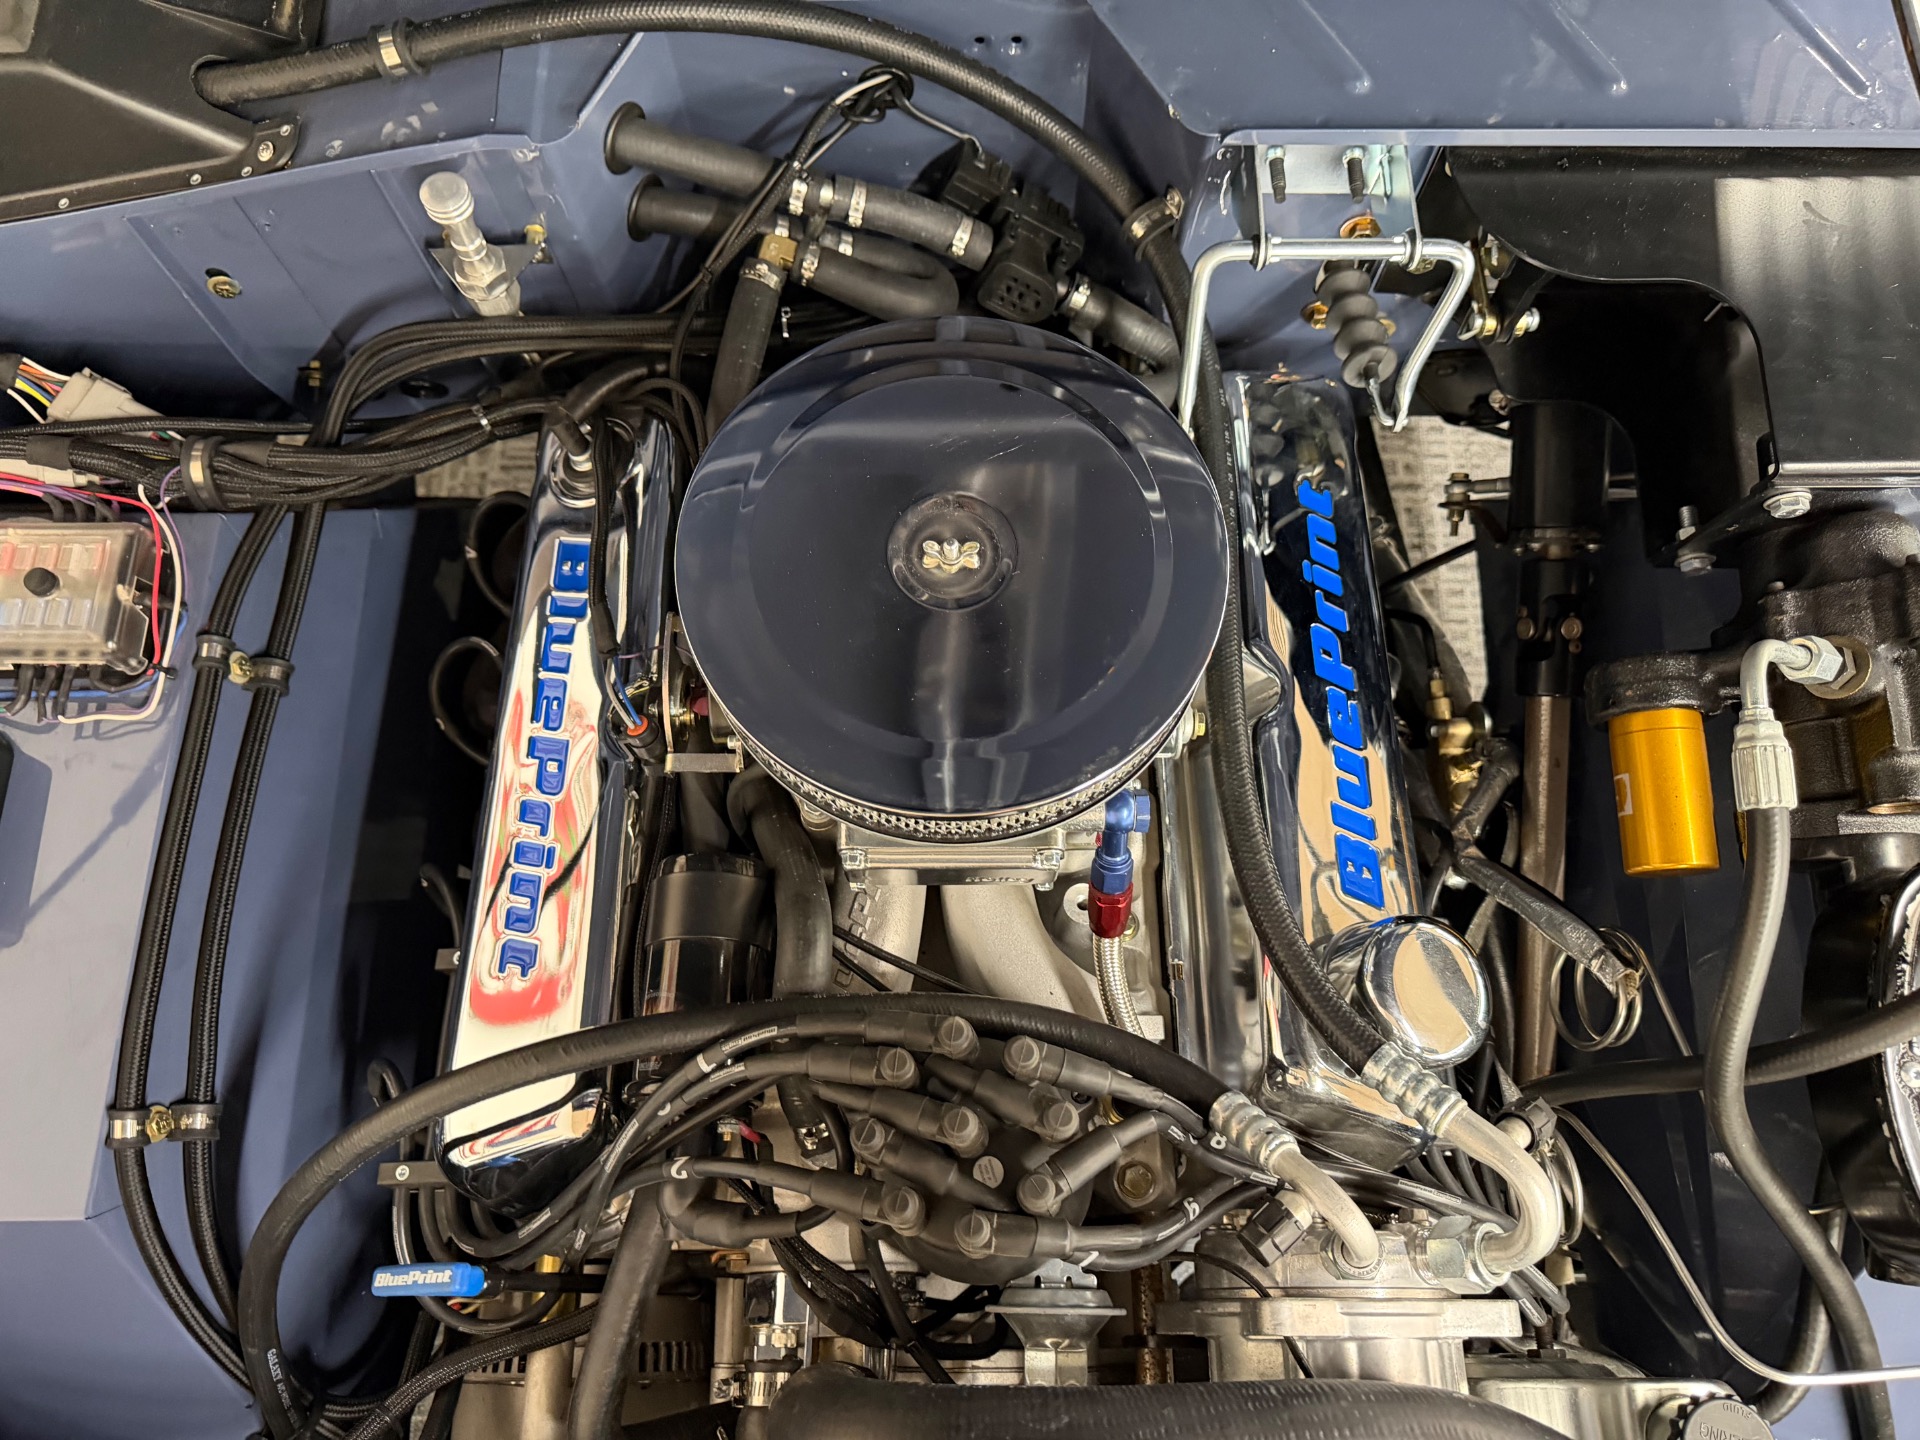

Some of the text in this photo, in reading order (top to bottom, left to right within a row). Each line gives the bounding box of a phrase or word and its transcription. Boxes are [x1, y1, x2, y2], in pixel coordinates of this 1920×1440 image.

[1298, 479, 1384, 909] BluePrint
[498, 537, 591, 979] BluePrint
[670, 1156, 691, 1179] 2
[374, 1269, 453, 1287] BluePrint
[266, 1348, 283, 1382] GALAXY
[1722, 1402, 1752, 1419] FLUID
